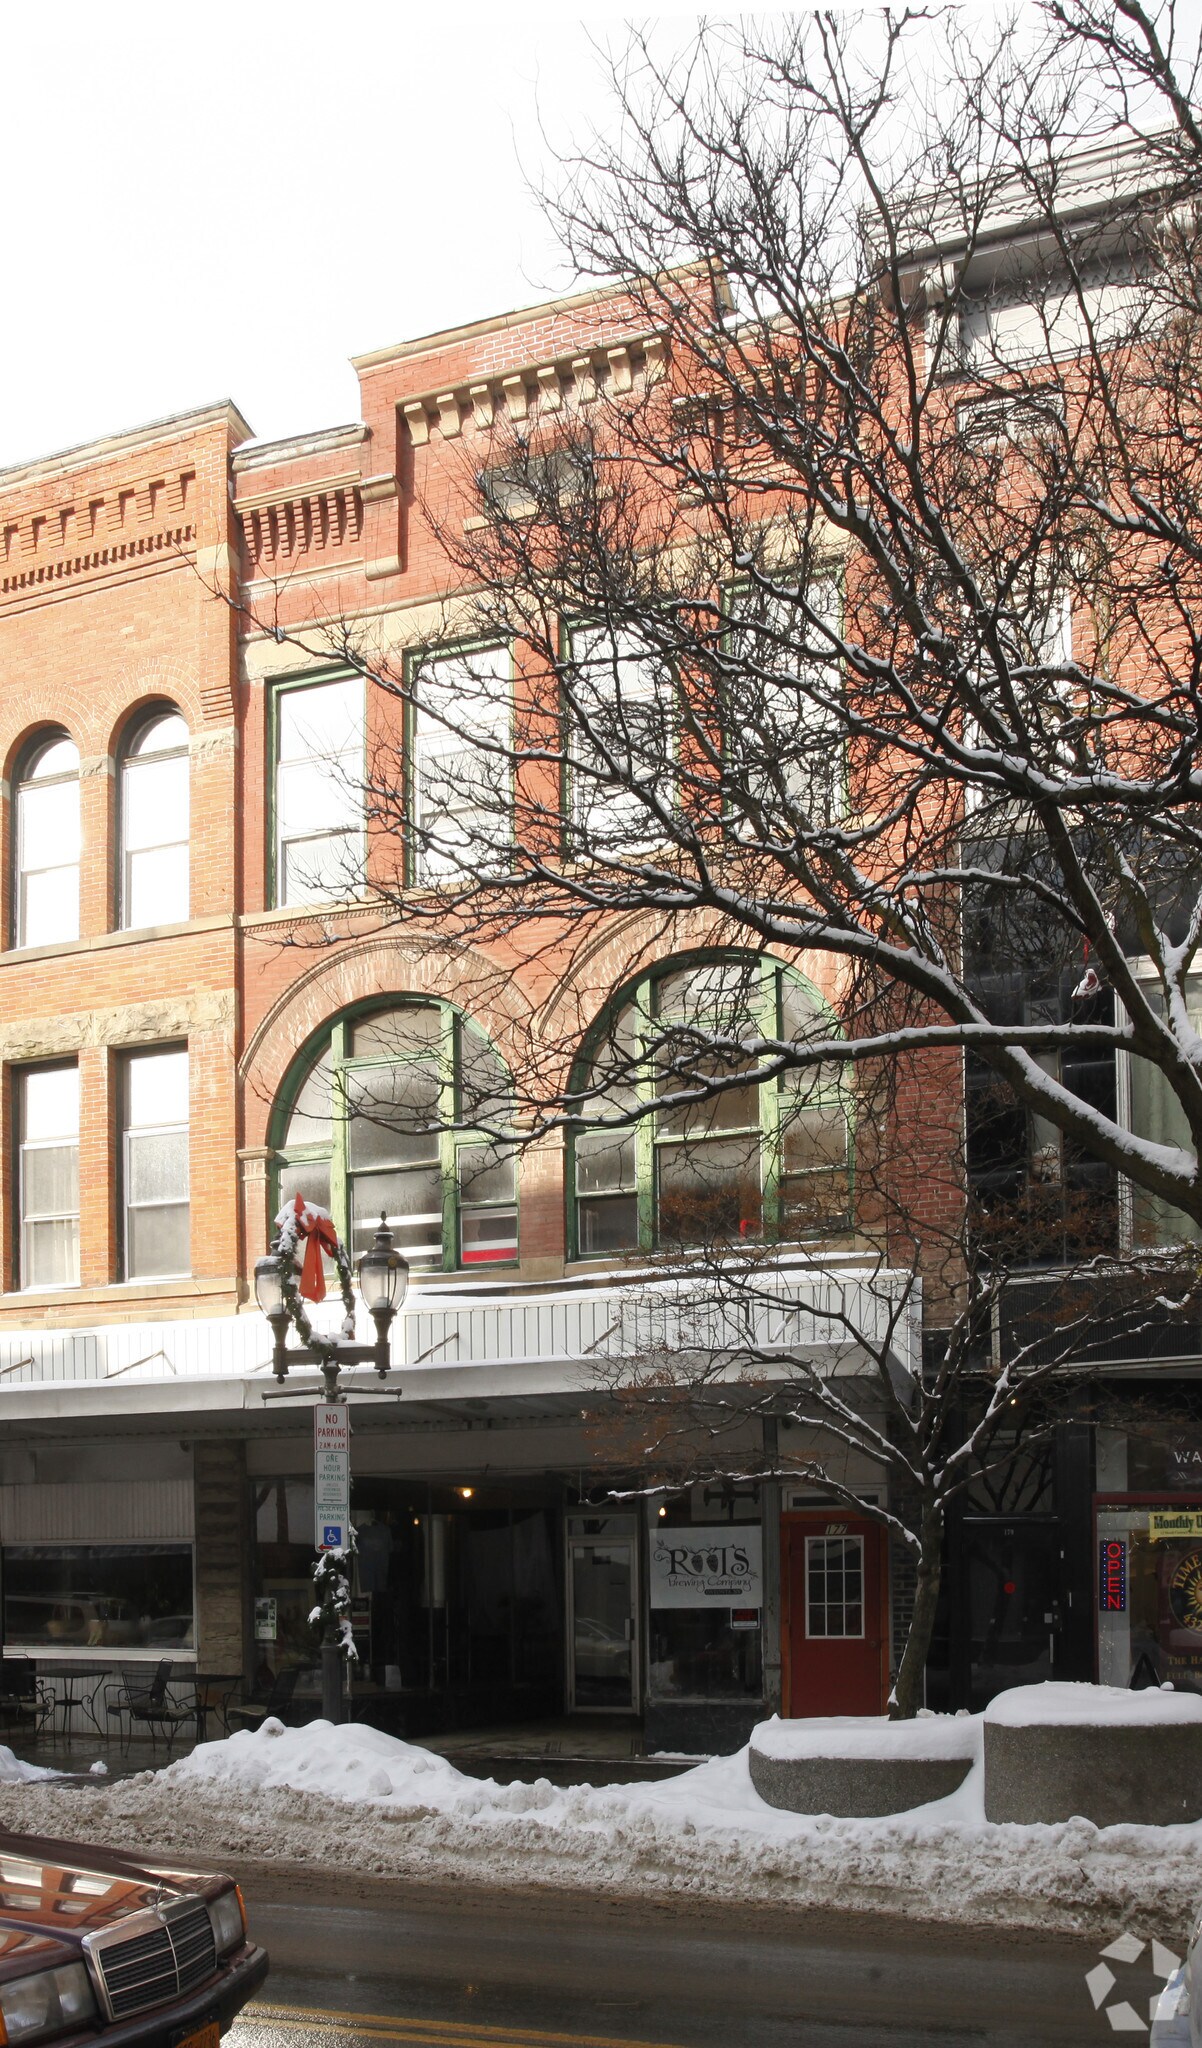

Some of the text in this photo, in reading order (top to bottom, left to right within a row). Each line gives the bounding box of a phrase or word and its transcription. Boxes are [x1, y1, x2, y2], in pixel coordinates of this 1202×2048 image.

[325, 1413, 338, 1425] NO
[317, 1427, 347, 1438] PARKING
[325, 1454, 339, 1463] ONE
[323, 1464, 341, 1472] HOUR
[318, 1473, 346, 1482] PARKING
[319, 1513, 346, 1522] PARKING
[1153, 1515, 1194, 1533] Monthly
[654, 1543, 757, 1577] ROOTS
[1107, 1542, 1121, 1609] OPEN
[1173, 1554, 1202, 1589] TIME
[668, 1575, 752, 1593] Brewing Company
